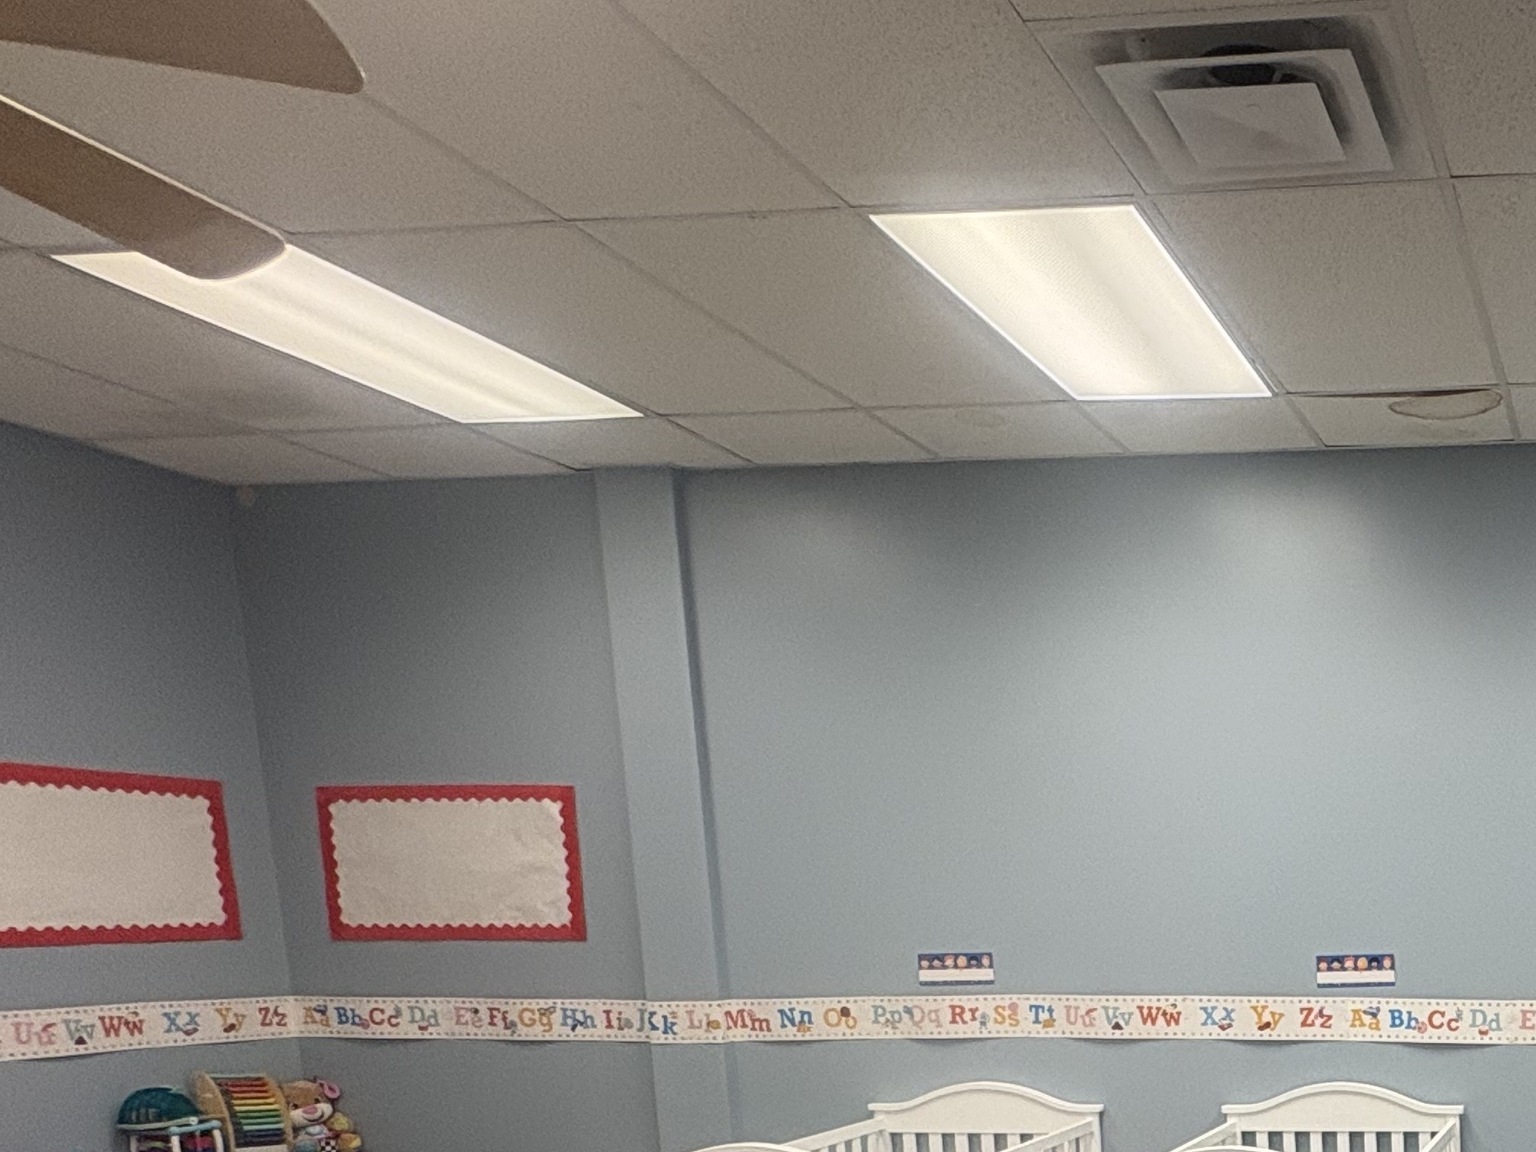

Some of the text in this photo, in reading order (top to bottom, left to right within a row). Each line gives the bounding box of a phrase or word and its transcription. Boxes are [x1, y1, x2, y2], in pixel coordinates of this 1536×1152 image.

[63, 1017, 95, 1043] Vv
[99, 1014, 144, 1037] Ww
[162, 1010, 200, 1036] Xx
[215, 1006, 247, 1033] Yy
[257, 1005, 288, 1027] Zz
[302, 1005, 331, 1028] Aa
[334, 1005, 364, 1028] Bb
[369, 1006, 400, 1027] Cc
[407, 1005, 441, 1028] Dd
[453, 1006, 484, 1029] Ee
[487, 1006, 511, 1030] Ff
[517, 1006, 553, 1032] Gg
[560, 1006, 597, 1029] Hh
[602, 1008, 626, 1031] Ii
[723, 1007, 772, 1033] Mm
[779, 1006, 814, 1030] Nn
[823, 1006, 858, 1030] Oo
[871, 1004, 902, 1030] Pp
[910, 1005, 943, 1030] Qq
[948, 1004, 980, 1025] Rr
[993, 1005, 1020, 1028] Ss
[1029, 1004, 1056, 1028] Tt
[1063, 1004, 1096, 1028] Uu
[1101, 1004, 1134, 1030] Vv
[1136, 1004, 1182, 1027] Ww
[1201, 1005, 1236, 1027] Xx
[1250, 1005, 1286, 1032] Yy
[1299, 1006, 1334, 1029] Zz
[1349, 1008, 1382, 1032] Aa
[1388, 1009, 1420, 1031] Bb
[1427, 1009, 1461, 1031] Cc
[1469, 1008, 1503, 1032] Dd
